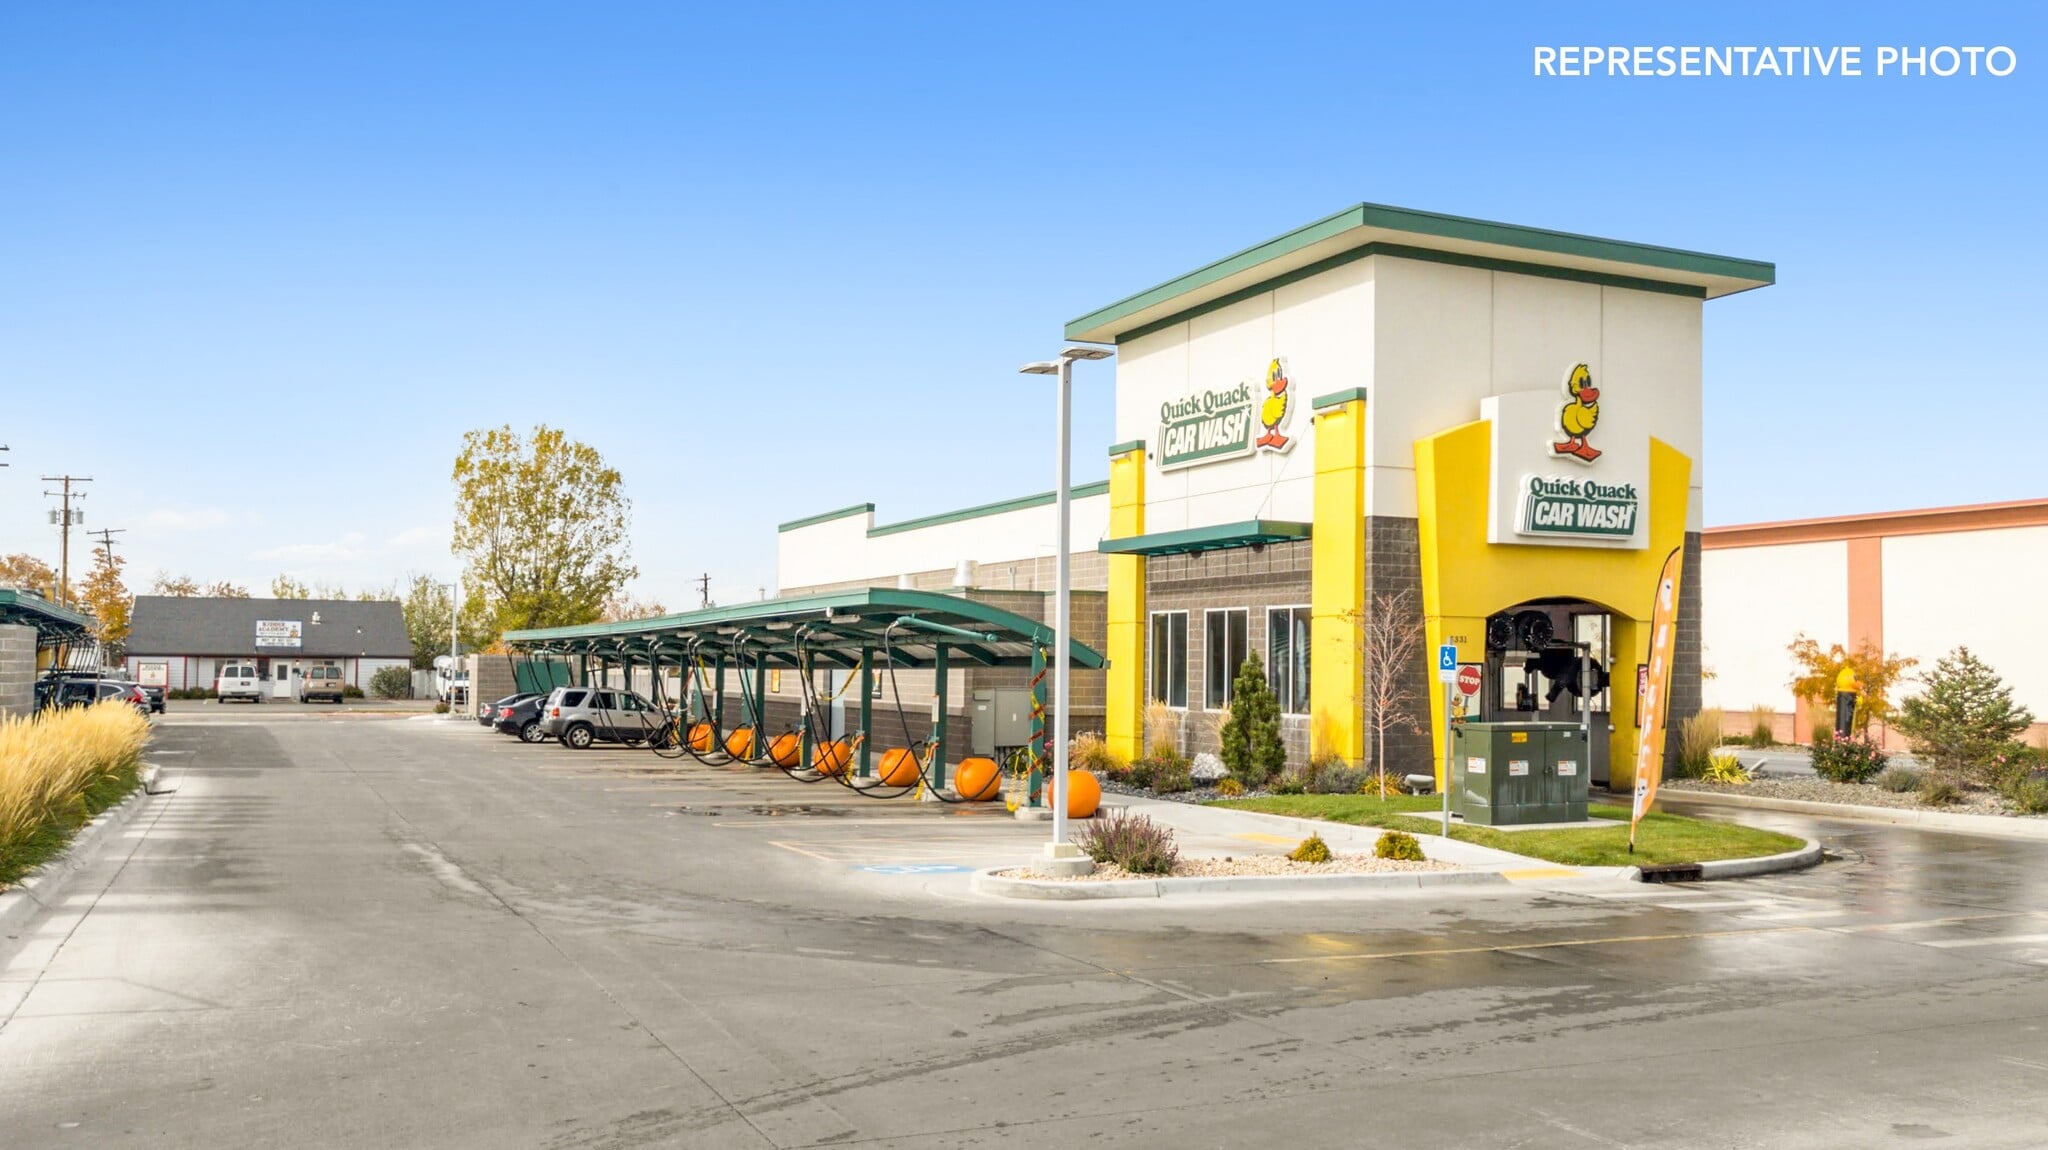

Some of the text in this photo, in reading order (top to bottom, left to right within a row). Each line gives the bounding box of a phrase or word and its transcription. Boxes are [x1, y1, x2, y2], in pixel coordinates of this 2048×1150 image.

[1161, 382, 1250, 424] Quick Quack
[1164, 412, 1246, 458] CAR WASH
[1530, 476, 1637, 500] Quick Quack
[1535, 501, 1632, 529] CAR WASH
[1459, 675, 1481, 685] STOP
